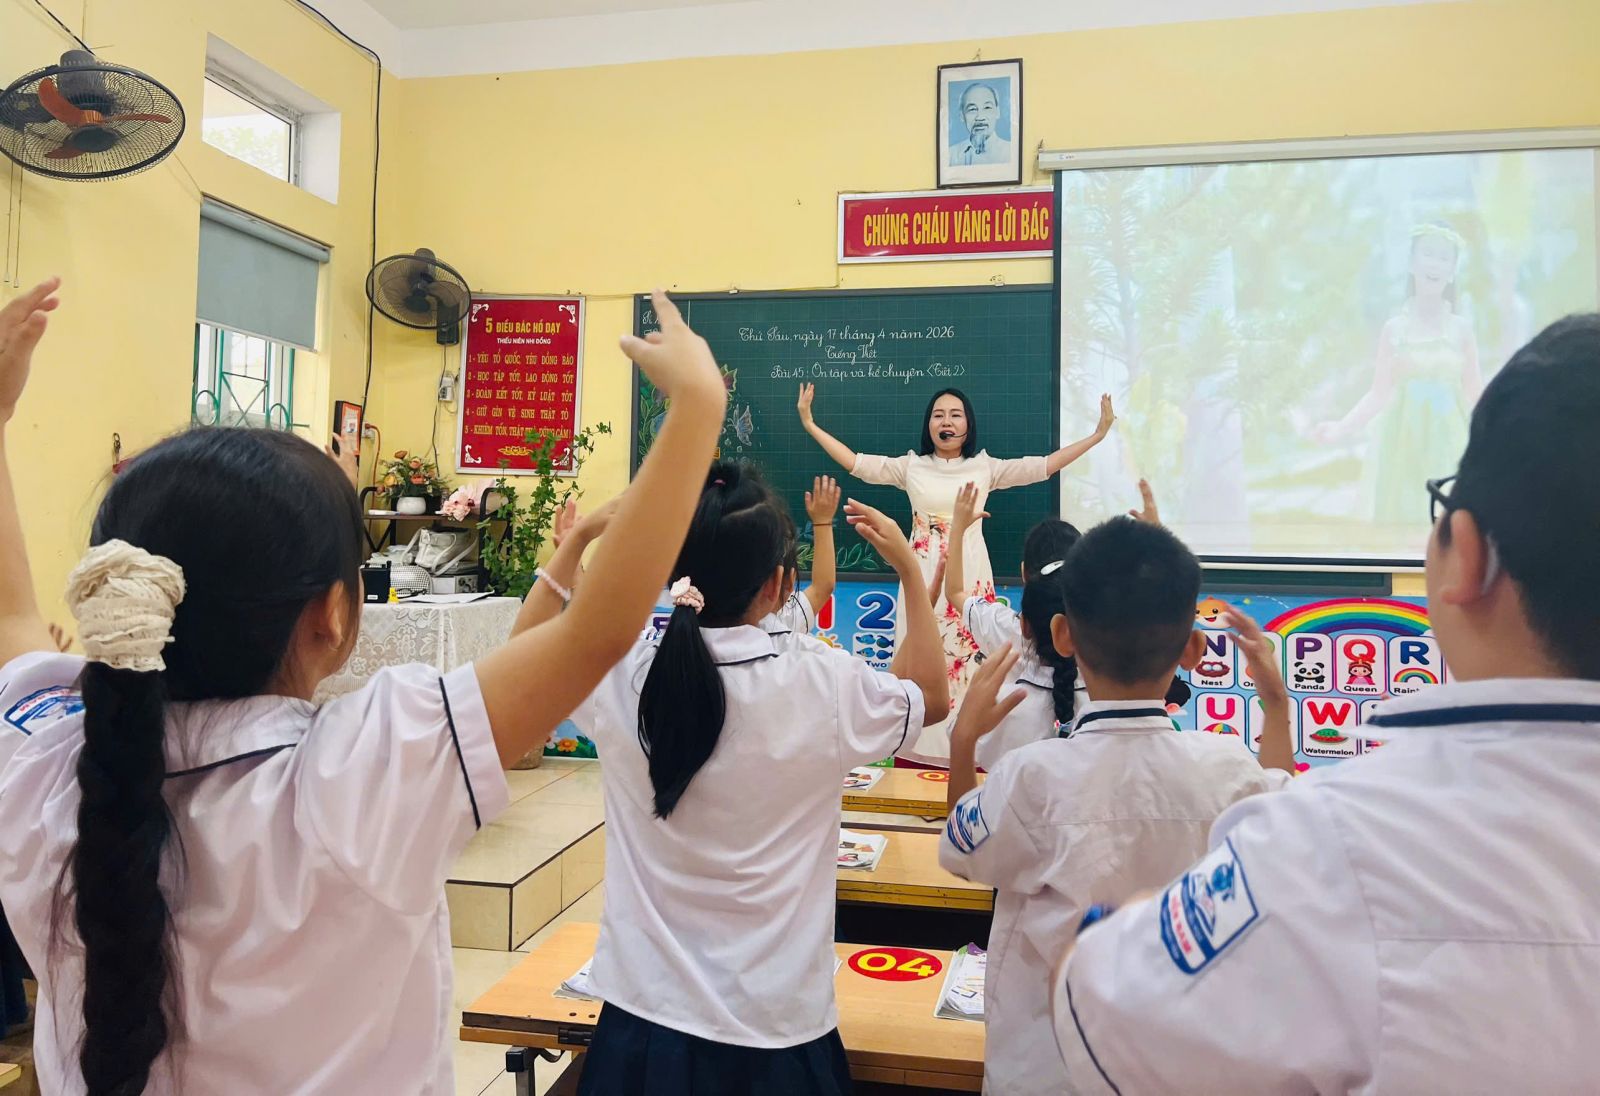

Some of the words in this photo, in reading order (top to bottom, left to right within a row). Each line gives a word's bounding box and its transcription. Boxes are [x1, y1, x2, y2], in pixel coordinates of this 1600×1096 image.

[863, 207, 909, 247] CHÚNG
[912, 205, 950, 245] CHÁU
[953, 203, 991, 243] VÂNG
[994, 201, 1016, 242] LỜI
[1020, 200, 1049, 241] BÁC
[485, 317, 493, 334] 5
[515, 319, 531, 333] BÁC
[545, 322, 561, 336] DẠY
[738, 326, 763, 342] Thứ
[793, 330, 824, 348] ngày
[827, 327, 837, 340] 17
[839, 324, 875, 348] tháng
[878, 327, 886, 340] 4
[889, 329, 924, 340] năm
[925, 325, 956, 340] 2026
[512, 336, 525, 345] NIÊN
[525, 337, 535, 345] NHI
[477, 351, 489, 364] YÊU
[525, 351, 538, 365] YÊU
[824, 344, 857, 366] Tiếng
[477, 371, 490, 384] HỌC
[493, 369, 505, 385] TẬP
[525, 372, 538, 383] LAO
[541, 370, 559, 386] ĐỘNG
[562, 370, 575, 384] TỐT
[770, 364, 791, 379] Bài
[811, 361, 828, 378] Ôn
[829, 367, 849, 382] tập
[850, 367, 866, 378] và
[867, 363, 882, 378] kể
[881, 363, 925, 385] chuyện
[475, 386, 493, 399] ĐOÀN
[496, 386, 508, 400] KẾT
[540, 388, 556, 404] LUẬT
[561, 389, 573, 402] TỐT
[476, 404, 488, 417] GIỮ
[508, 405, 516, 420] VỆ
[520, 408, 535, 419] SINH
[540, 407, 556, 421] THẬT
[508, 424, 525, 439] THẬT
[858, 592, 895, 630] 2
[1203, 634, 1227, 657] N
[1296, 637, 1322, 660] P
[1343, 639, 1376, 664] Q
[1400, 641, 1430, 665] R
[1201, 679, 1223, 687] Nest
[1294, 683, 1325, 692] Panda
[1343, 685, 1378, 694] Queen
[1206, 696, 1236, 721] U
[1306, 700, 1352, 726] W
[1305, 747, 1354, 757] Watermelon
[856, 952, 935, 977] 04
